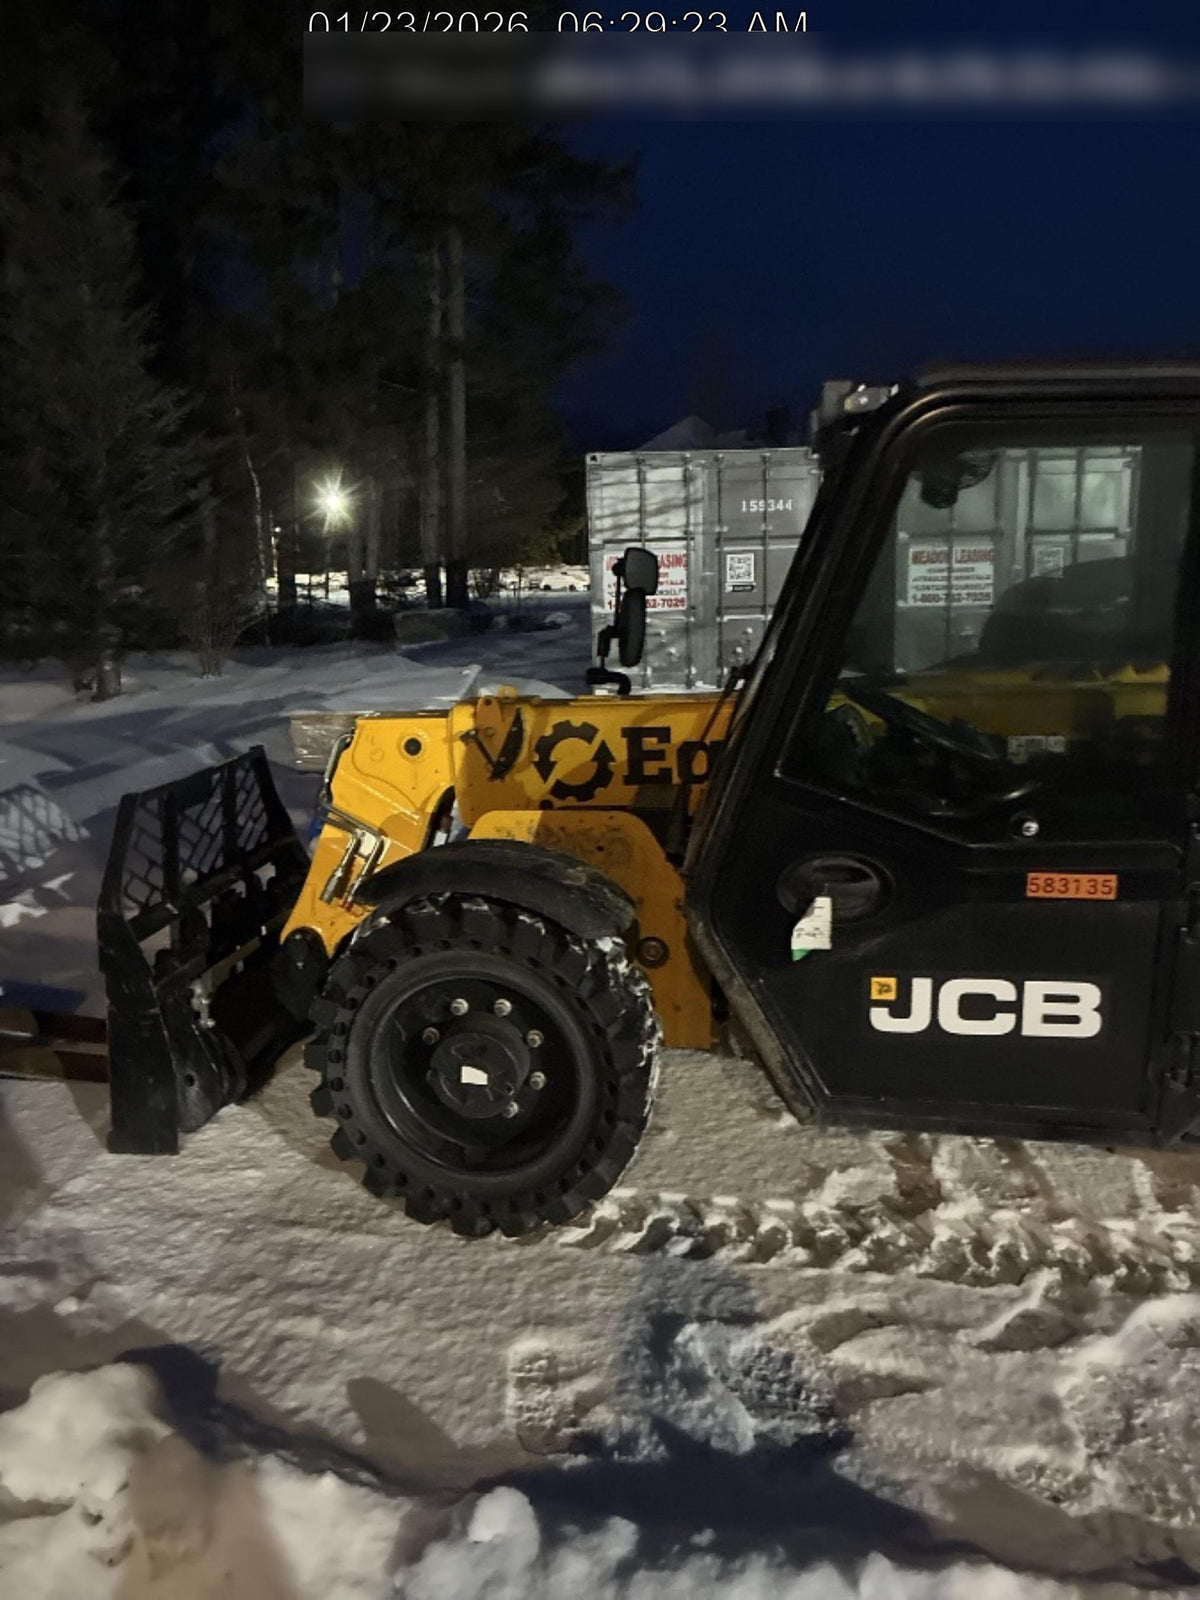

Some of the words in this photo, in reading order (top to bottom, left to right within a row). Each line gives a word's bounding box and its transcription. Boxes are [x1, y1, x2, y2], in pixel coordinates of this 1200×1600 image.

[657, 553, 689, 570] ASING
[1027, 876, 1114, 896] 583135
[869, 977, 1102, 1038] JCB
